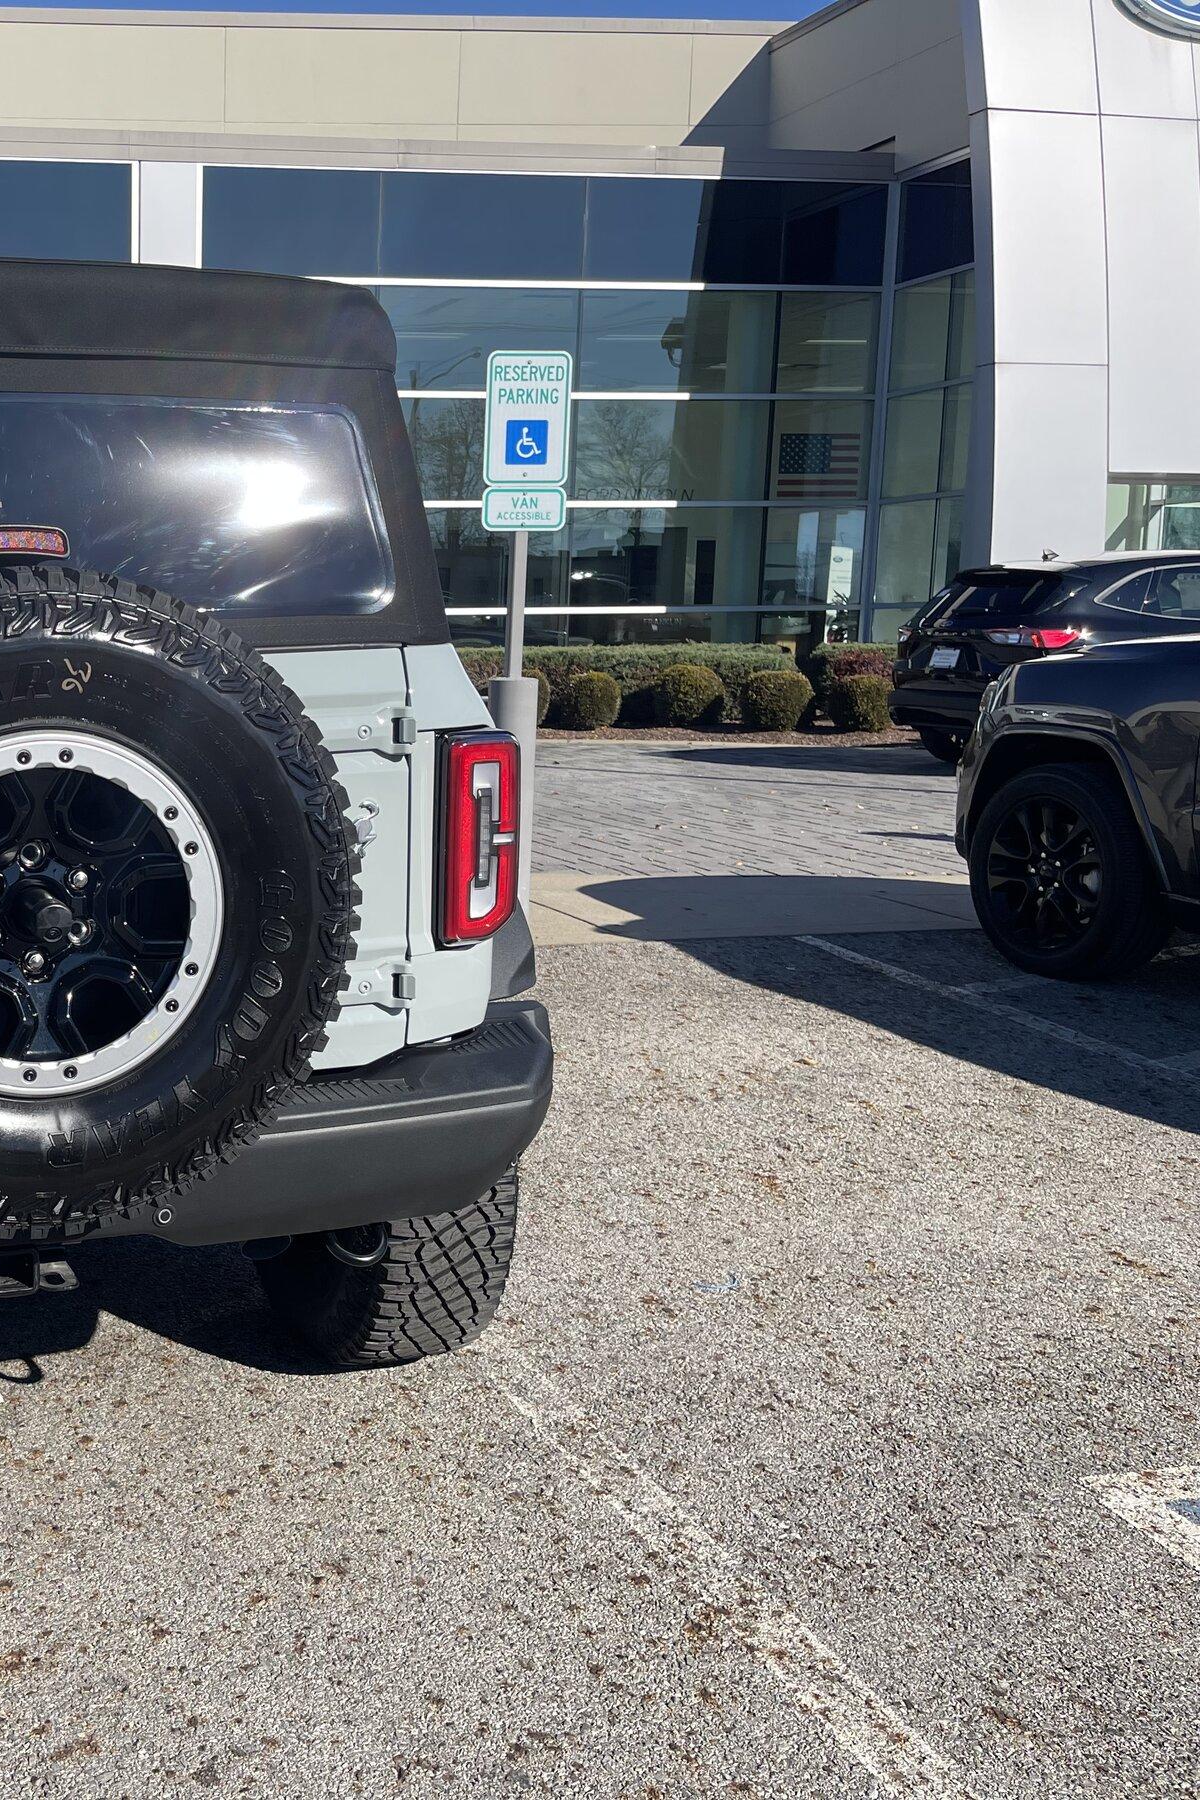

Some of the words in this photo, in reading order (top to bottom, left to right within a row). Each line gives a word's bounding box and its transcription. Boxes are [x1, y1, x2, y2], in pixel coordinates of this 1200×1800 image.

[494, 365, 565, 382] RESERVED
[498, 388, 559, 404] PARKING
[511, 497, 538, 509] VAN
[496, 512, 551, 520] ACCESSIBLE
